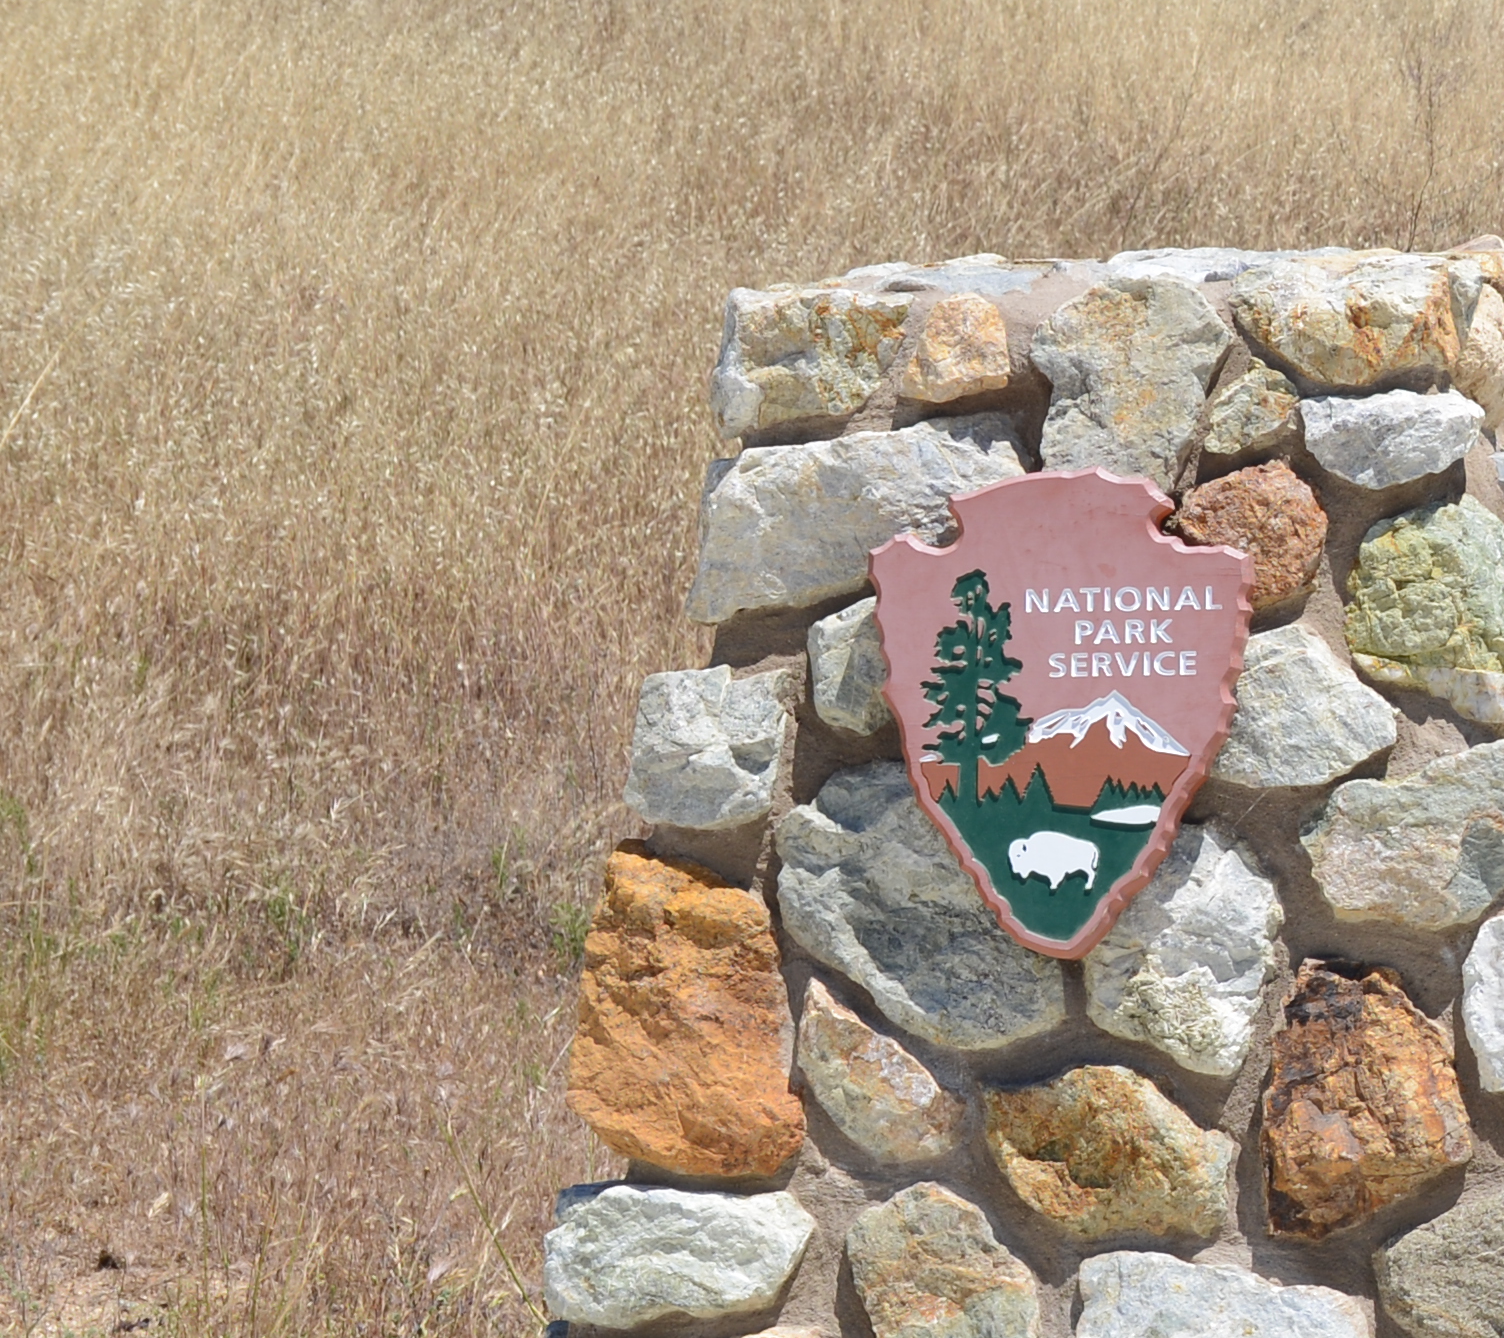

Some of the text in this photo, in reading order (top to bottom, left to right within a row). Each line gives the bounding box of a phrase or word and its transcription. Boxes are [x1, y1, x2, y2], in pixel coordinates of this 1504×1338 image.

[1025, 585, 1223, 612] NATIONAL
[1074, 618, 1173, 645] PARK
[1048, 650, 1197, 678] SERVICE
